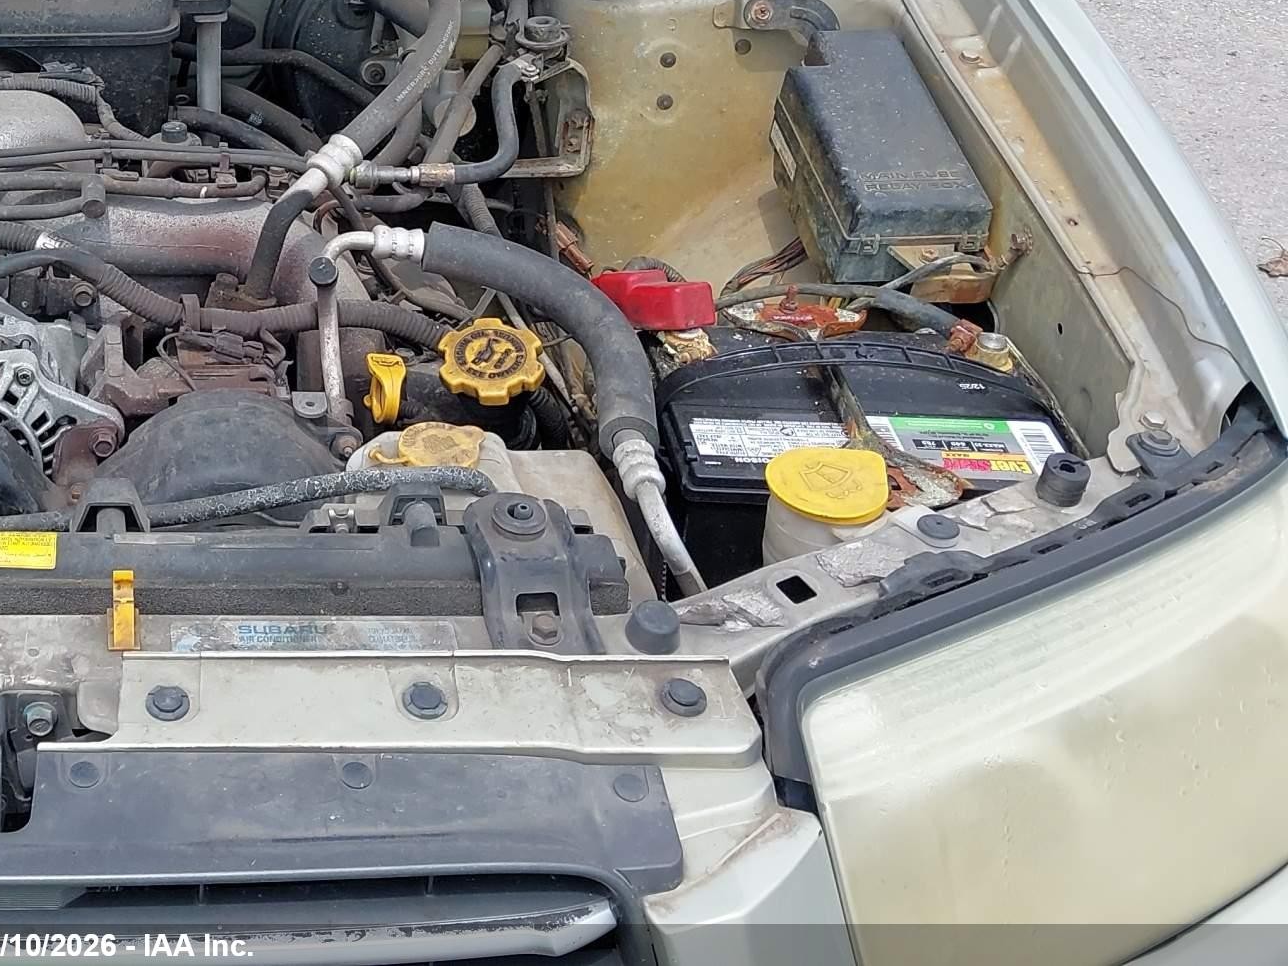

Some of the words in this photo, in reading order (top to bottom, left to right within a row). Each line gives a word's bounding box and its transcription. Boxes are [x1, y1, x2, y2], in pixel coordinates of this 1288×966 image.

[859, 170, 905, 179] MAIN
[911, 169, 961, 179] FUSE
[864, 182, 922, 192] RELAY
[238, 625, 328, 634] SUBARU
[238, 635, 254, 643] AIR
[256, 635, 317, 643] CONDITIONER
